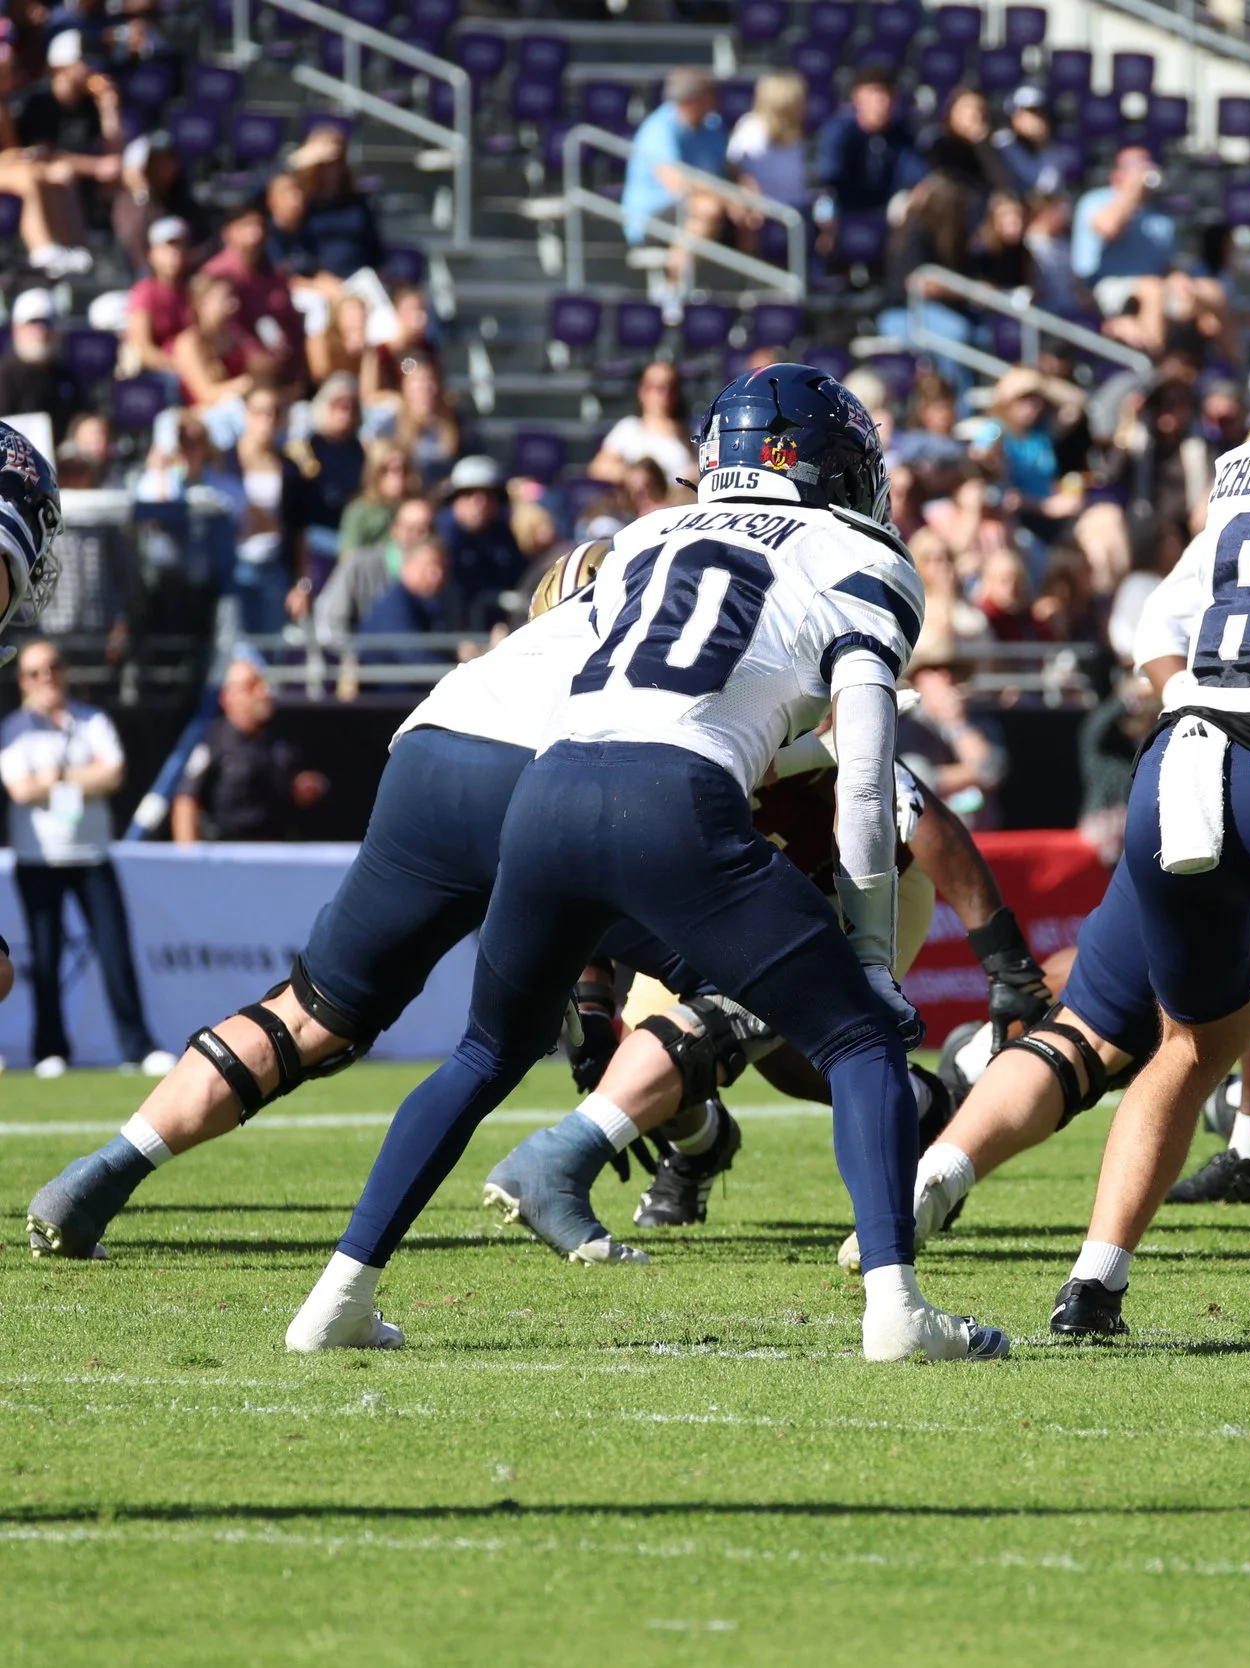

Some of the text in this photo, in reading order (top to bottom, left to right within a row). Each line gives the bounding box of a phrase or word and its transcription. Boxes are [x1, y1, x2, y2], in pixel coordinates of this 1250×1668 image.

[711, 471, 760, 492] OWLS
[660, 512, 807, 551] JACKSON
[570, 538, 776, 698] 10
